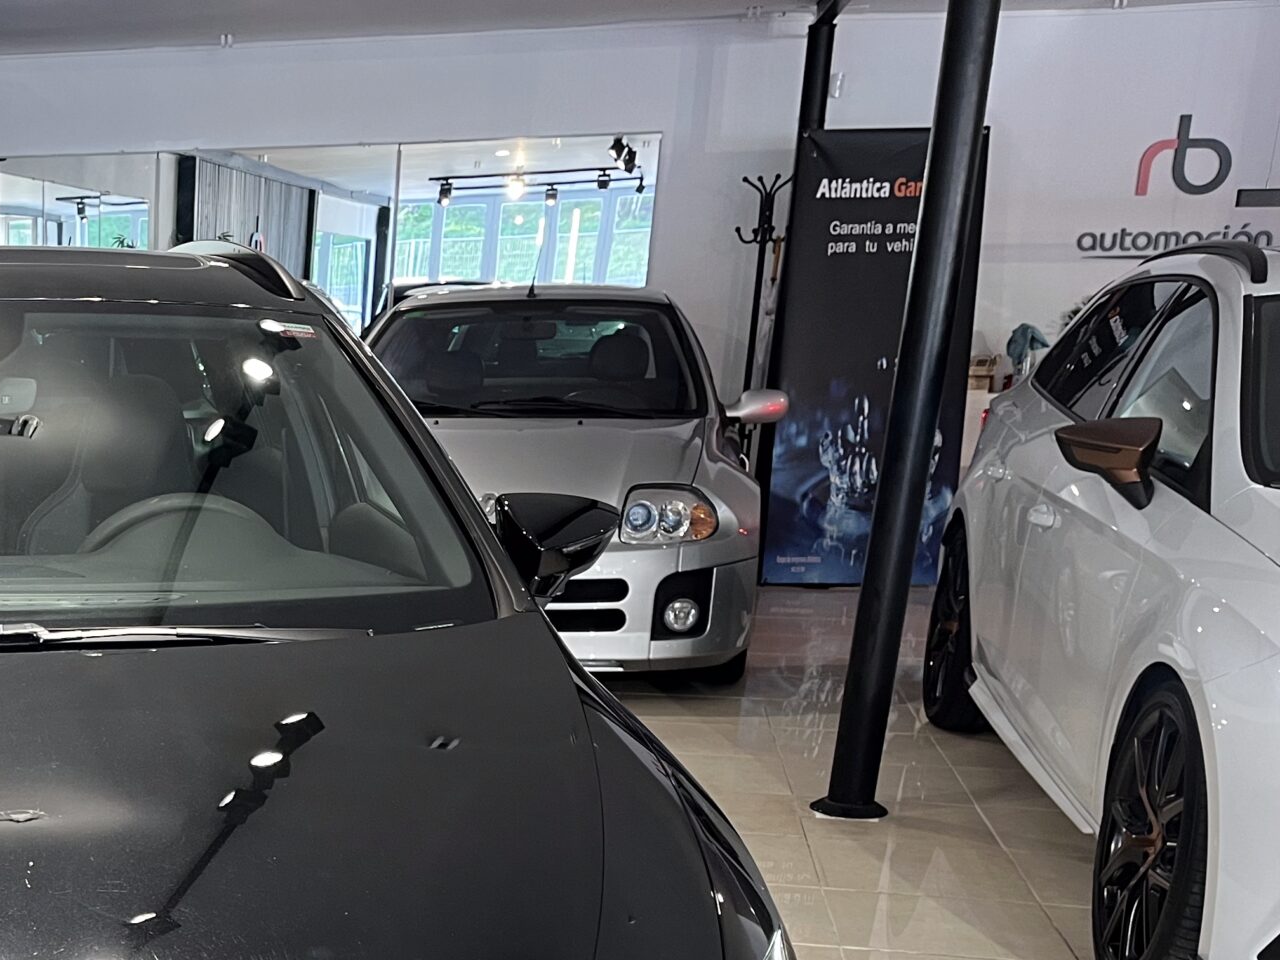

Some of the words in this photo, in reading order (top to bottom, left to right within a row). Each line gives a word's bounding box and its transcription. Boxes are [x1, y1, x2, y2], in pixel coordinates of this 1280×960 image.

[1134, 114, 1232, 196] rb
[815, 178, 891, 198] Atlántica
[884, 223, 894, 234] a
[827, 241, 857, 256] para
[865, 239, 878, 253] tu
